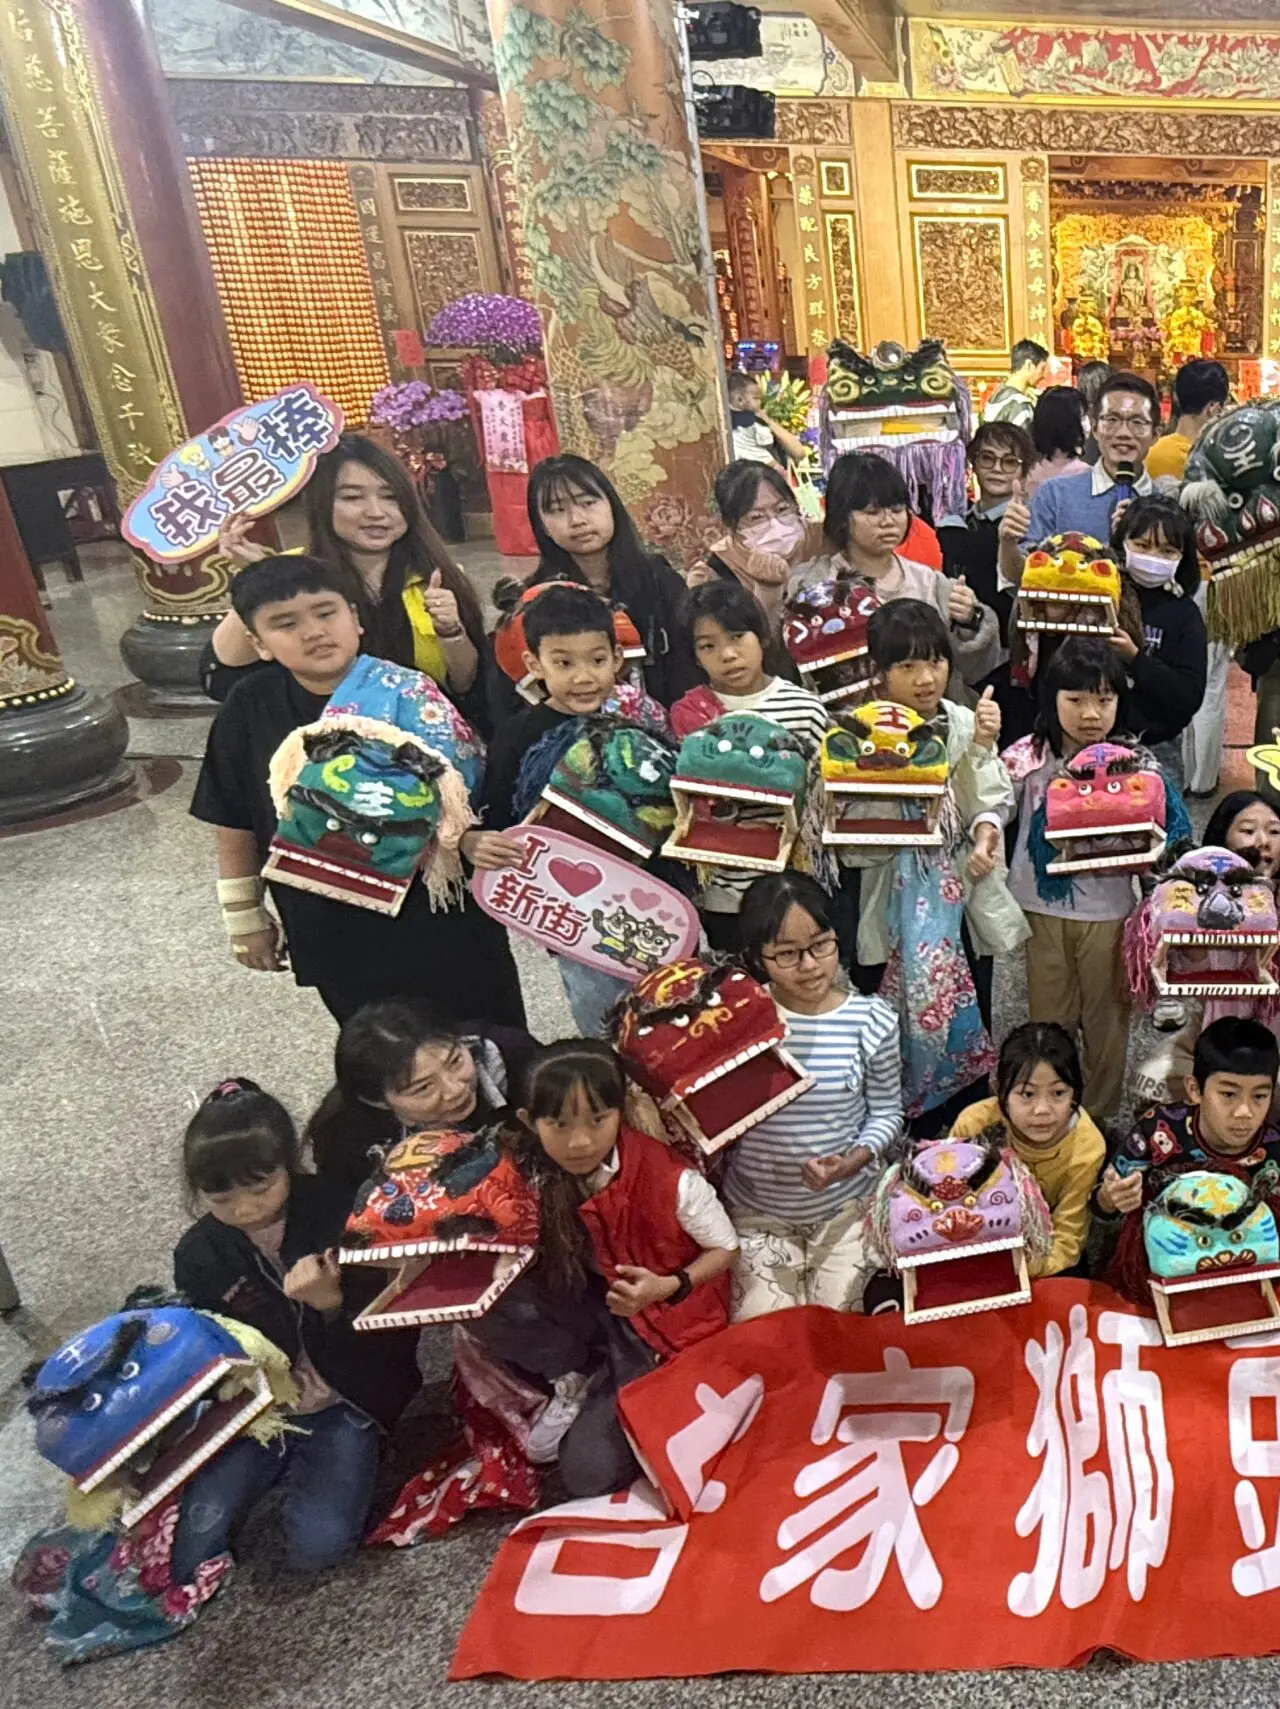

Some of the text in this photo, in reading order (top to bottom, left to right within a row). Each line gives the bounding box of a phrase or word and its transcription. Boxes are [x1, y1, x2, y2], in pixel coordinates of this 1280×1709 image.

[149, 388, 334, 547] 我最棒
[517, 834, 549, 877] I
[488, 872, 590, 946] 新街
